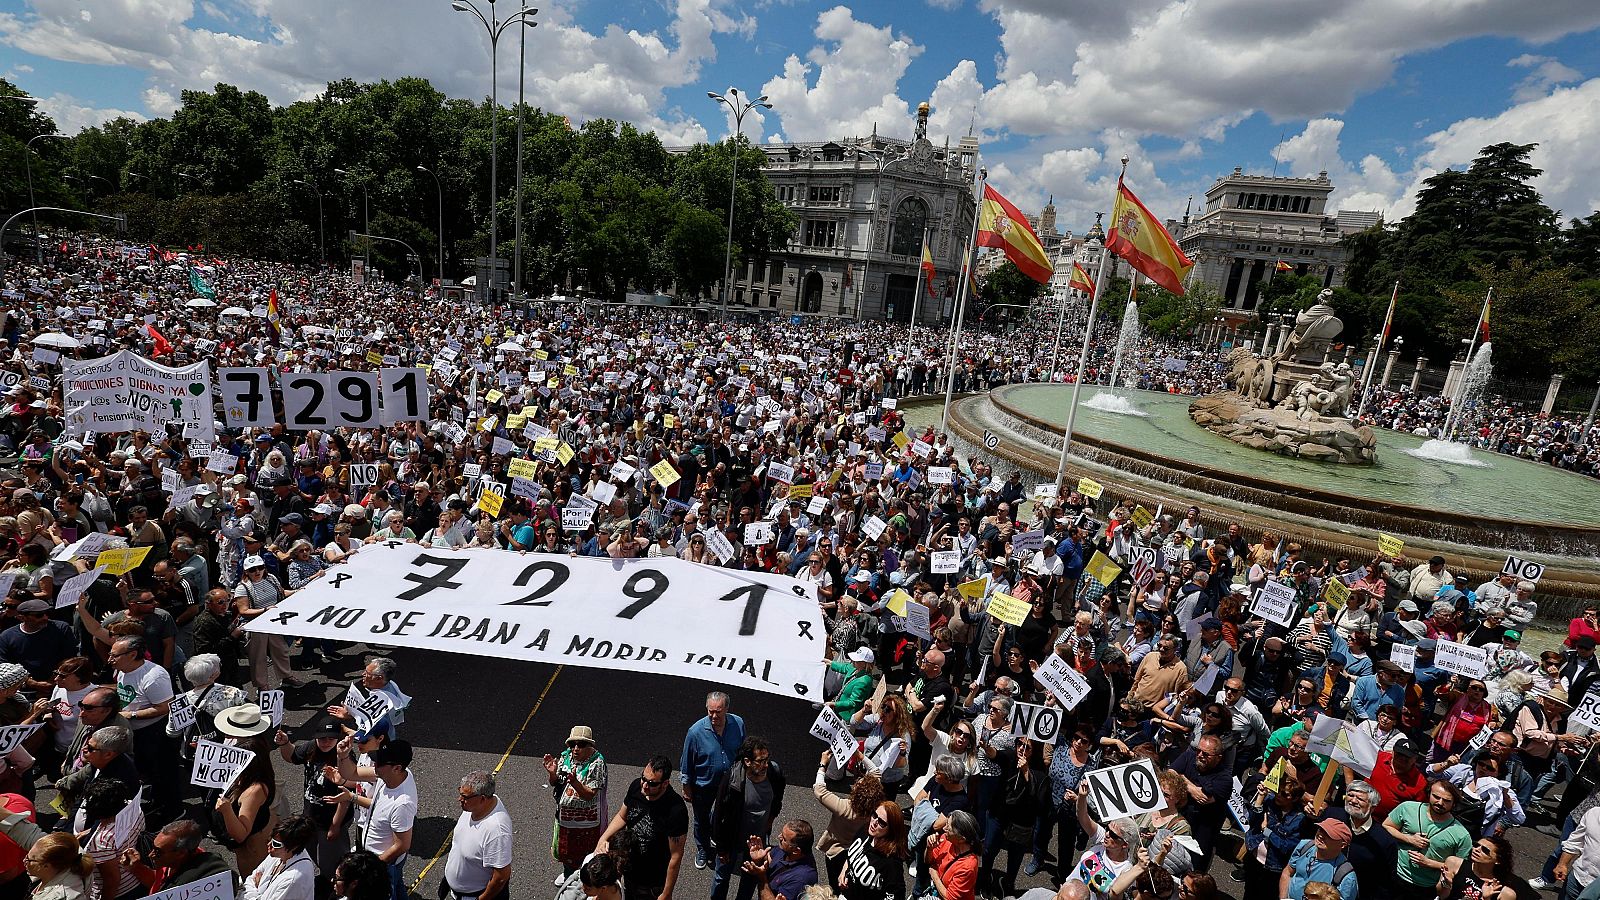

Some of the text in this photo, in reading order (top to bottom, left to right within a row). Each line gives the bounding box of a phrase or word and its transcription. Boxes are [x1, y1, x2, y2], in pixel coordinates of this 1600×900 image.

[0, 371, 18, 387] O
[159, 371, 172, 380] nos
[129, 377, 165, 394] DIGNAS
[90, 396, 110, 406] L@s
[767, 401, 780, 413] NO
[351, 466, 378, 485] NO
[563, 519, 589, 527] SALUD
[1130, 547, 1156, 566] NO
[1132, 557, 1154, 587] NO
[1504, 556, 1541, 580] NO
[306, 605, 367, 629] NO
[369, 610, 426, 636] SE
[427, 613, 522, 647] IBAN
[524, 628, 551, 652] A
[1042, 671, 1054, 684] más
[1050, 658, 1083, 696] Sin Urgencias,
[171, 702, 182, 712] SE
[1575, 709, 1589, 721] TU
[175, 711, 187, 725] TU
[1011, 703, 1059, 741] NO
[813, 724, 832, 743] PARA
[832, 739, 839, 750] EL
[821, 709, 854, 751] NO HAY CURA
[201, 744, 216, 761] TU
[196, 762, 210, 780] MI
[1091, 765, 1159, 818] NO
